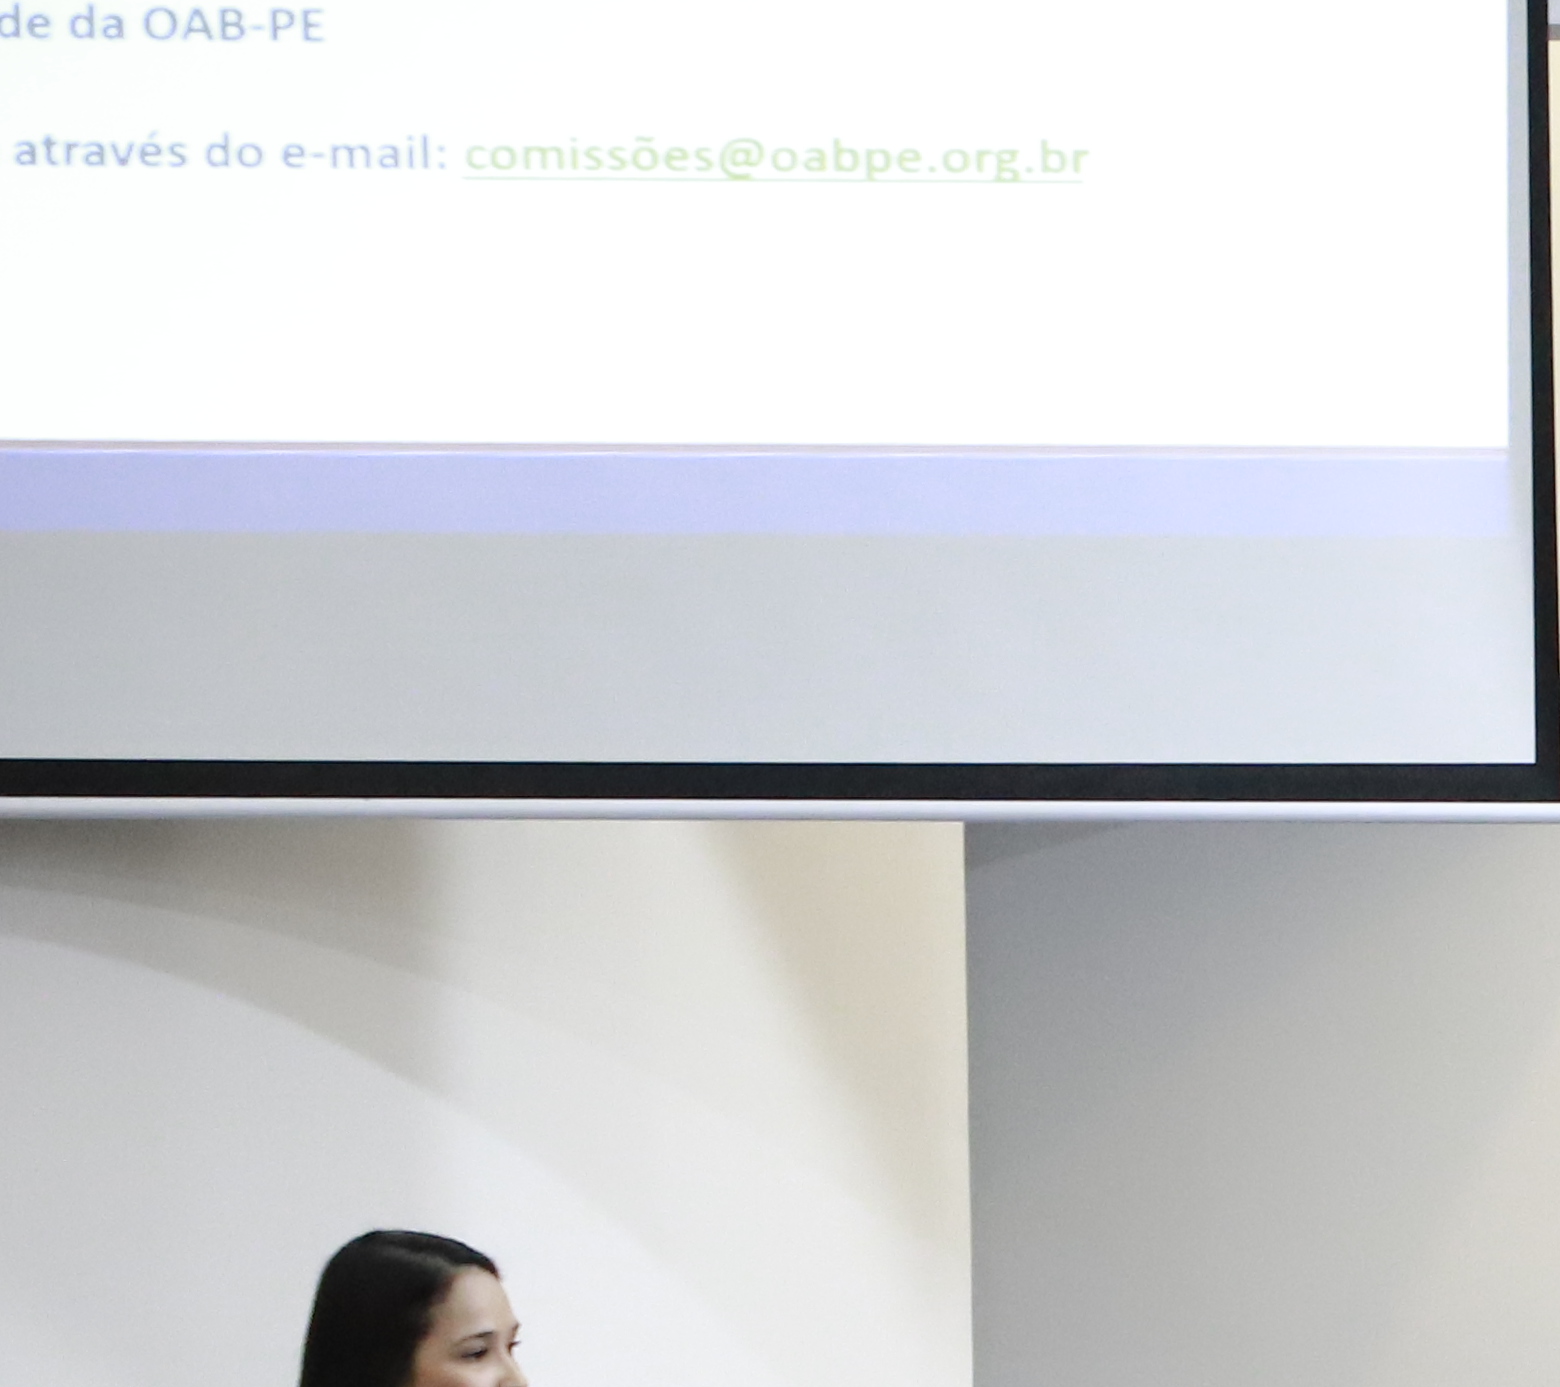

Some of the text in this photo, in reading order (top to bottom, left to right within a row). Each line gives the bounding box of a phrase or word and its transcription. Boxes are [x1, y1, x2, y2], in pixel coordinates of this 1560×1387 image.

[68, 3, 126, 40] da
[142, 7, 324, 42] OAB-PE
[14, 132, 1090, 183] através do e-mail: comissões@oabpe.org.br
